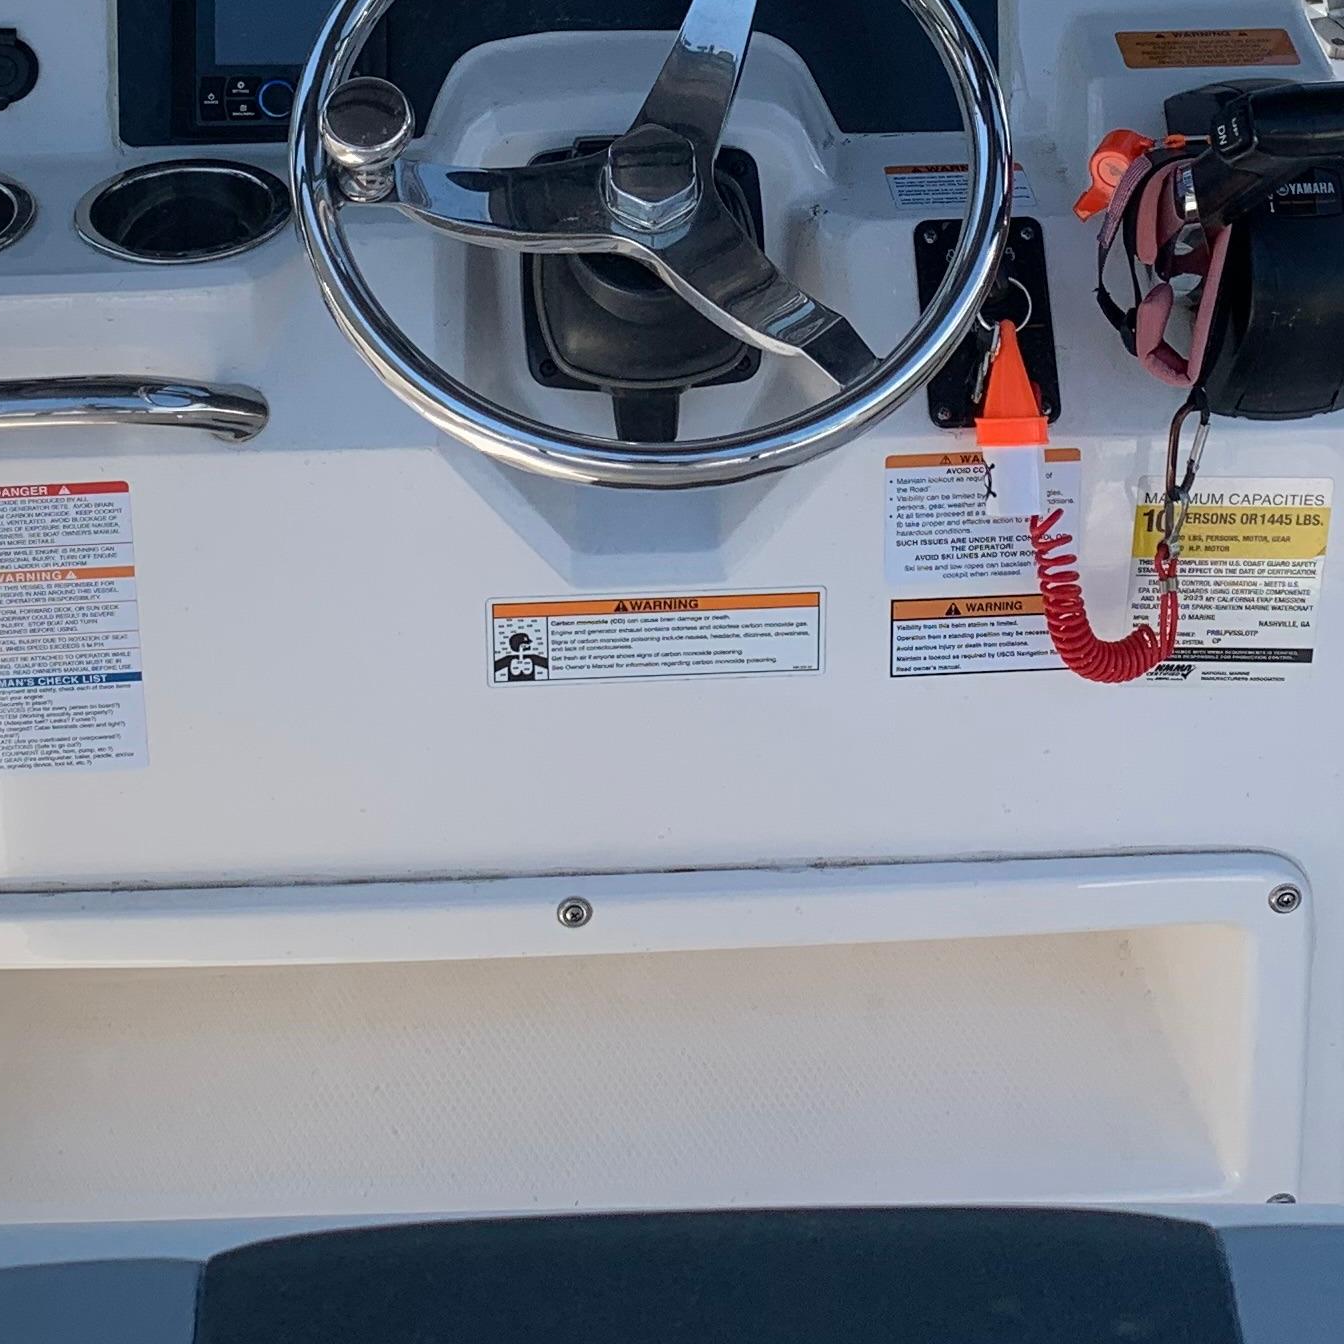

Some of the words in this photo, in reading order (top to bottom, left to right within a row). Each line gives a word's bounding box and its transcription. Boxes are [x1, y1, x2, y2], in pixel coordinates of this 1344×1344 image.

[1217, 125, 1227, 145] DN
[1289, 182, 1335, 194] YAMAHA
[897, 495, 925, 503] Visibility
[1229, 493, 1324, 506] CAPACITIES
[936, 511, 965, 519] proceed
[1182, 513, 1236, 525] ERSONS
[1241, 513, 1258, 525] OR
[1260, 513, 1292, 526] 1445
[1296, 514, 1323, 526] LBS.
[897, 539, 918, 547] SUCH
[921, 538, 948, 546] ISSUES
[969, 536, 996, 544] UNDER
[999, 535, 1013, 543] THE
[915, 553, 939, 561] AVOID
[1001, 550, 1017, 558] TOW
[943, 571, 967, 580] cockpit
[629, 599, 699, 611] WARNING
[966, 601, 1022, 612] WARNING
[588, 628, 617, 636] generator
[897, 624, 921, 632] Visibility
[1017, 650, 1048, 658] Navigation
[660, 660, 693, 668] regarding
[38, 675, 79, 687] CHECK
[82, 674, 108, 684] LIST
